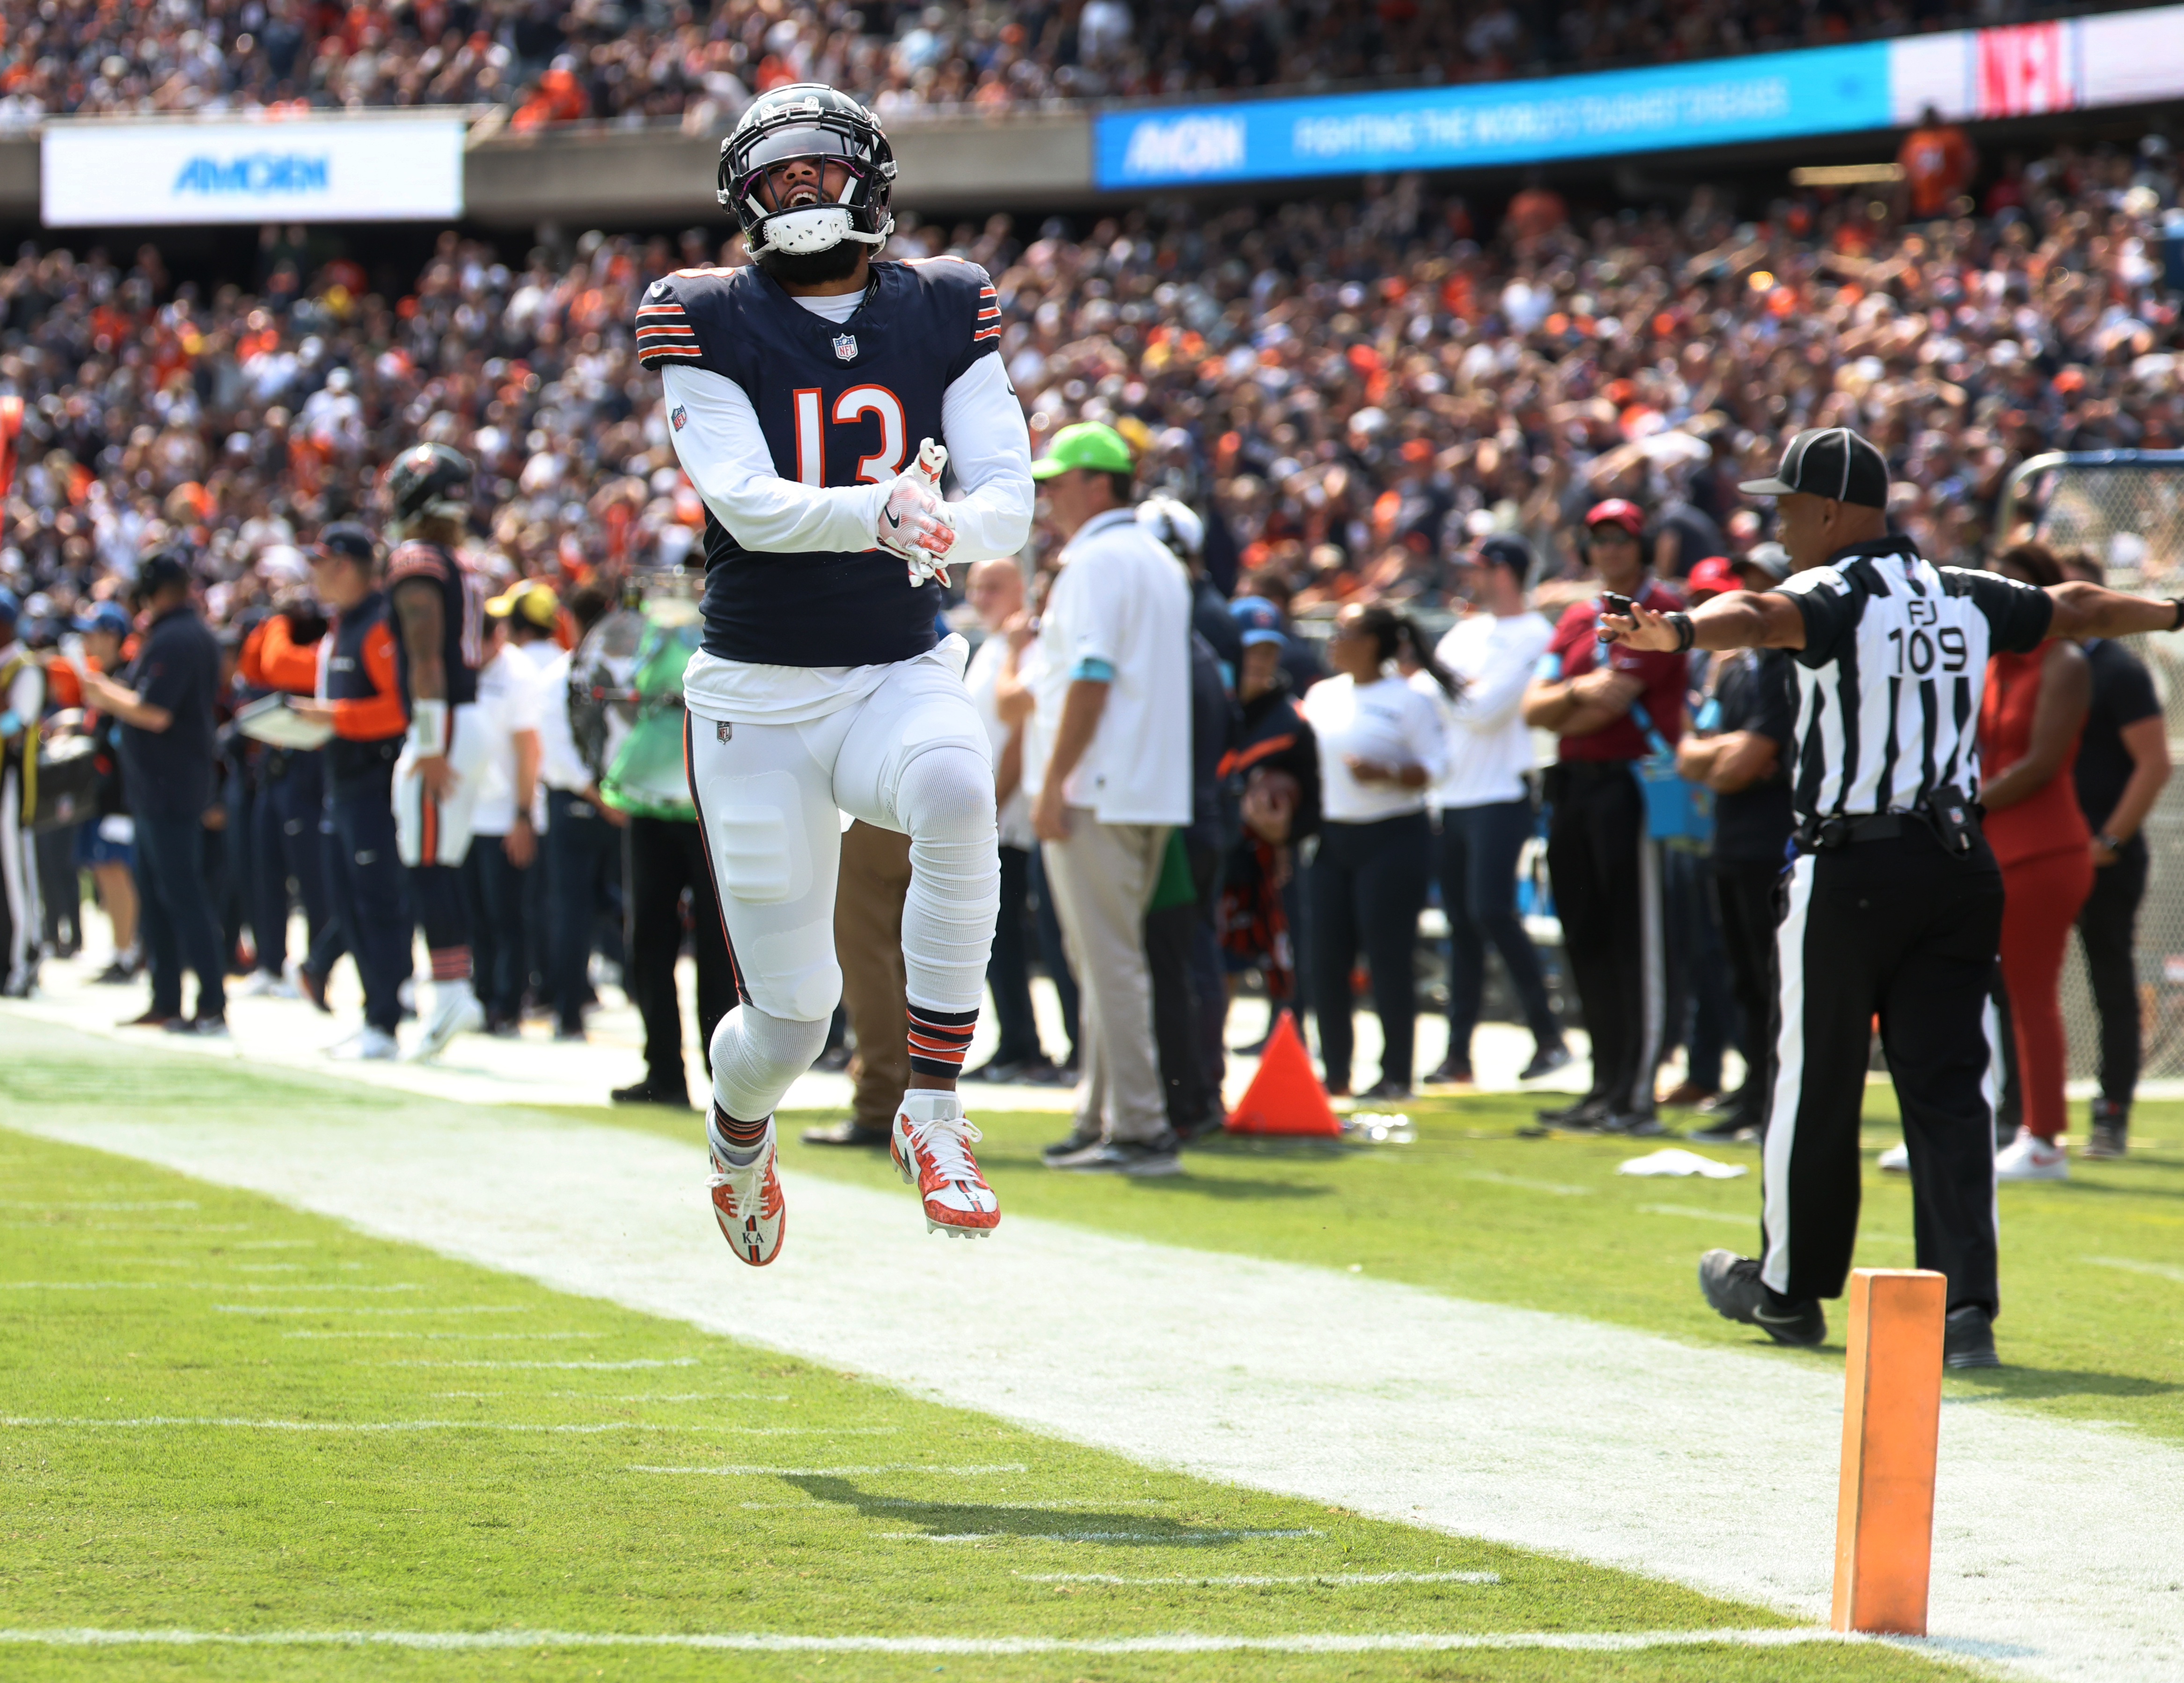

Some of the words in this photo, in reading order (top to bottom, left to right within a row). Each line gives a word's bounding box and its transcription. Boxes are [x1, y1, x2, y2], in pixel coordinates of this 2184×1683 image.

[839, 345, 855, 356] NFL
[674, 413, 686, 430] NFL
[793, 383, 907, 489] 13
[1908, 600, 1938, 626] FJ
[1888, 627, 1968, 674] 109
[718, 727, 729, 739] NFL
[964, 1192, 980, 1201] 13
